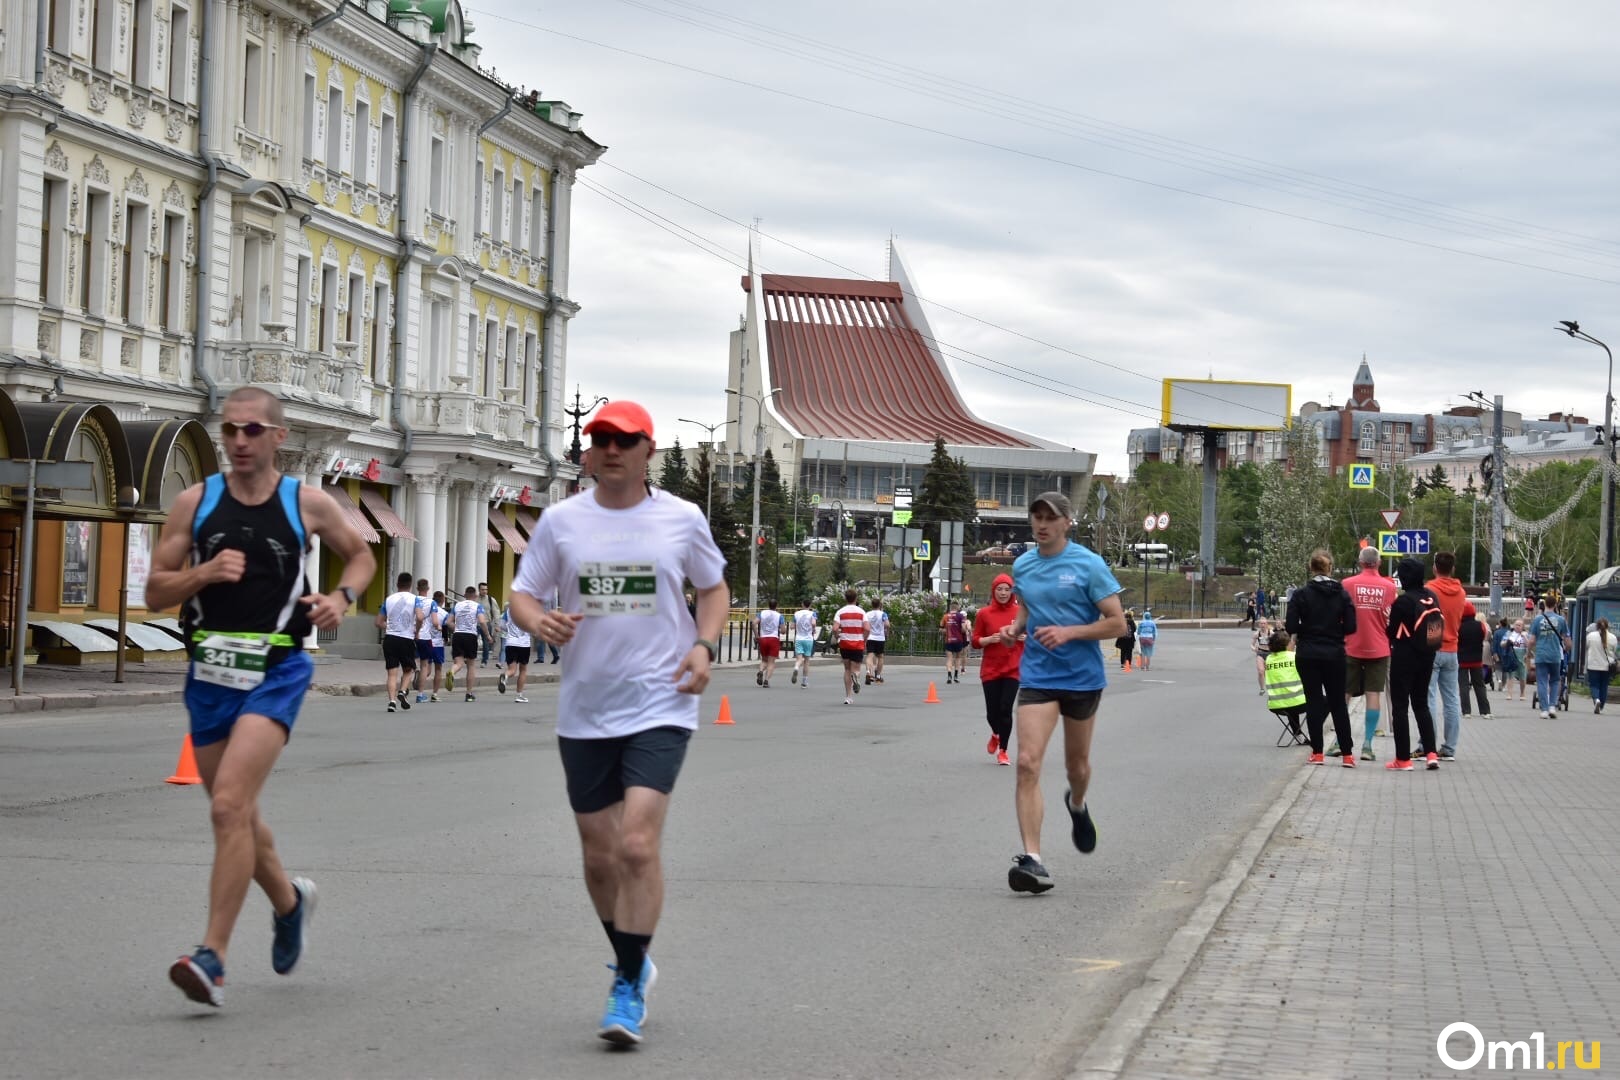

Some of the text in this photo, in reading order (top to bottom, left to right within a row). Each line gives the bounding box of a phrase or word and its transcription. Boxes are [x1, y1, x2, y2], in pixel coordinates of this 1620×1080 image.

[588, 577, 626, 594] 387
[1357, 587, 1384, 597] IRON
[1357, 596, 1383, 604] TEAM
[203, 649, 237, 667] 341
